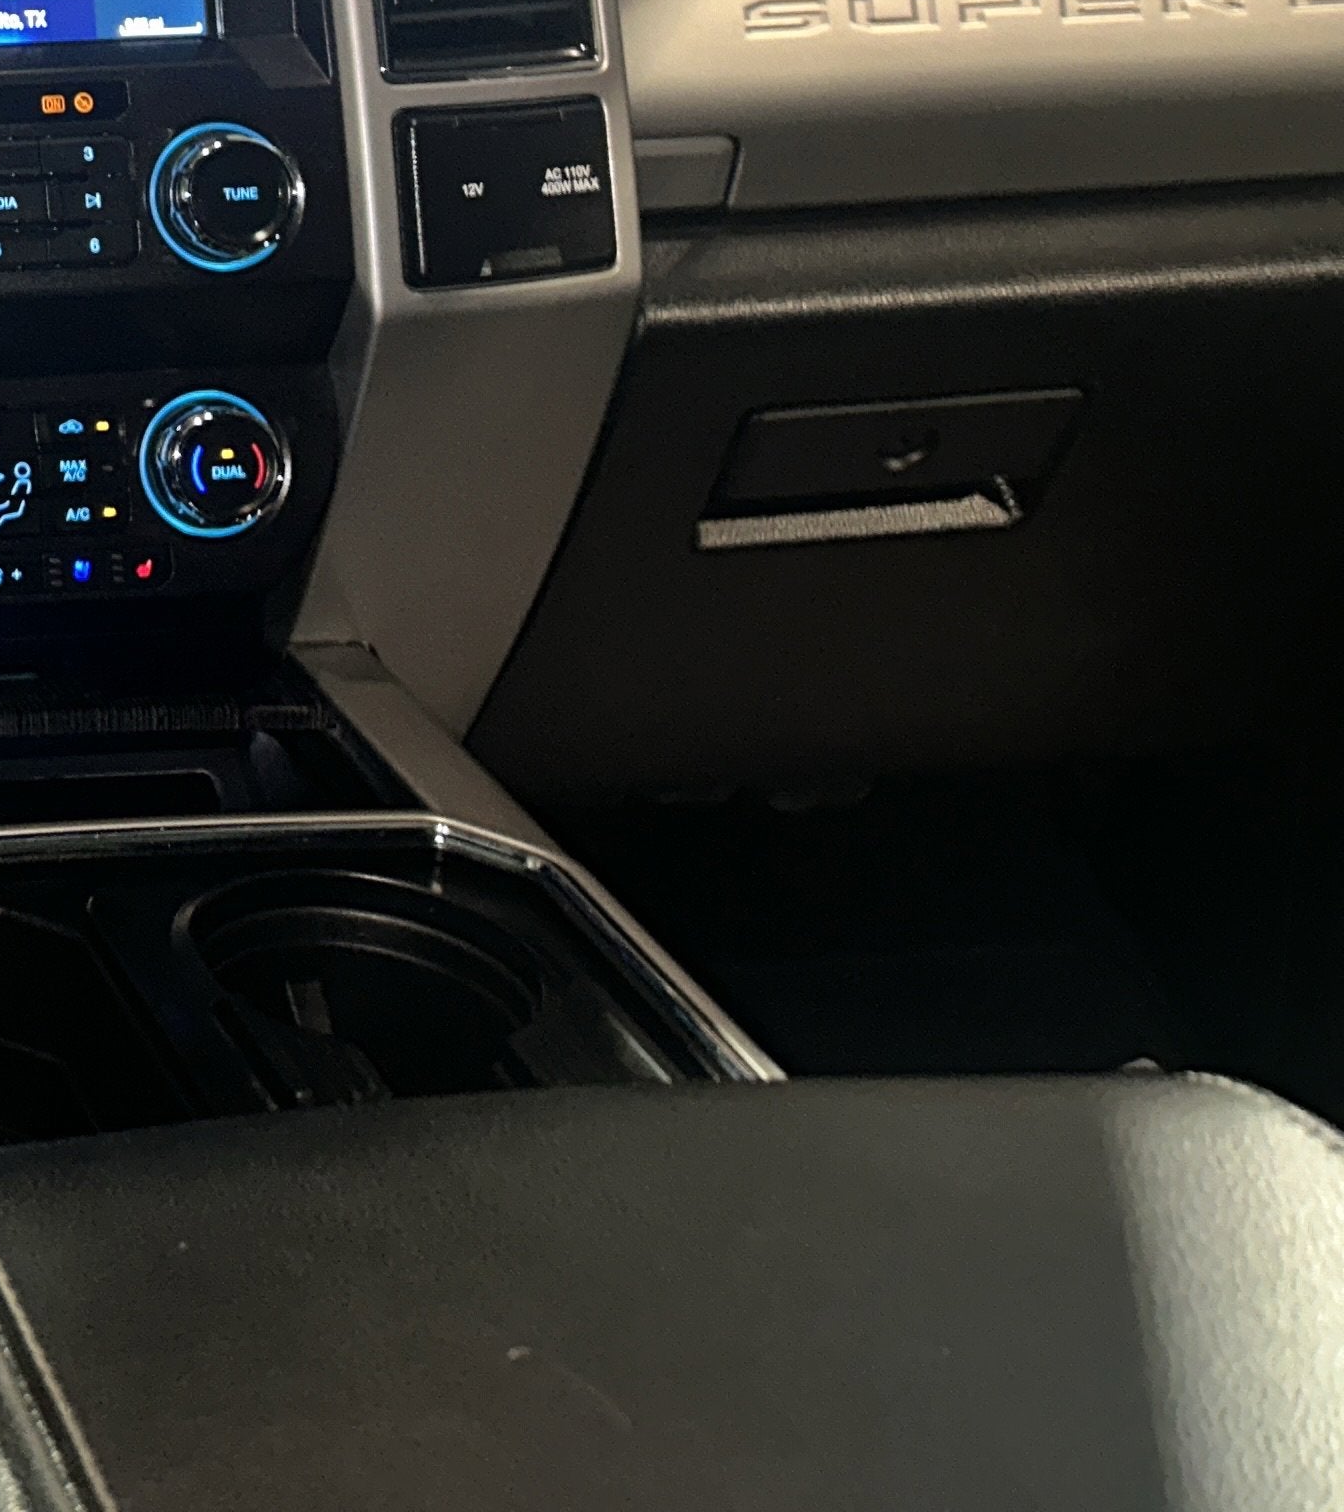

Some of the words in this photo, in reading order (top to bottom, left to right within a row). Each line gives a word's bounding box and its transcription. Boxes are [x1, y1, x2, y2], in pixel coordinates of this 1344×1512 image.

[24, 9, 48, 29] TX
[83, 146, 94, 161] 3
[545, 167, 562, 181] AC
[564, 164, 590, 179] 110V
[223, 186, 259, 201] TUNE
[462, 181, 484, 199] 12V
[541, 179, 572, 196] 400W
[573, 176, 600, 193] MAX
[90, 237, 101, 252] 6
[60, 459, 87, 473] MAX
[212, 465, 245, 480] DUAL
[66, 506, 91, 522] A/C
